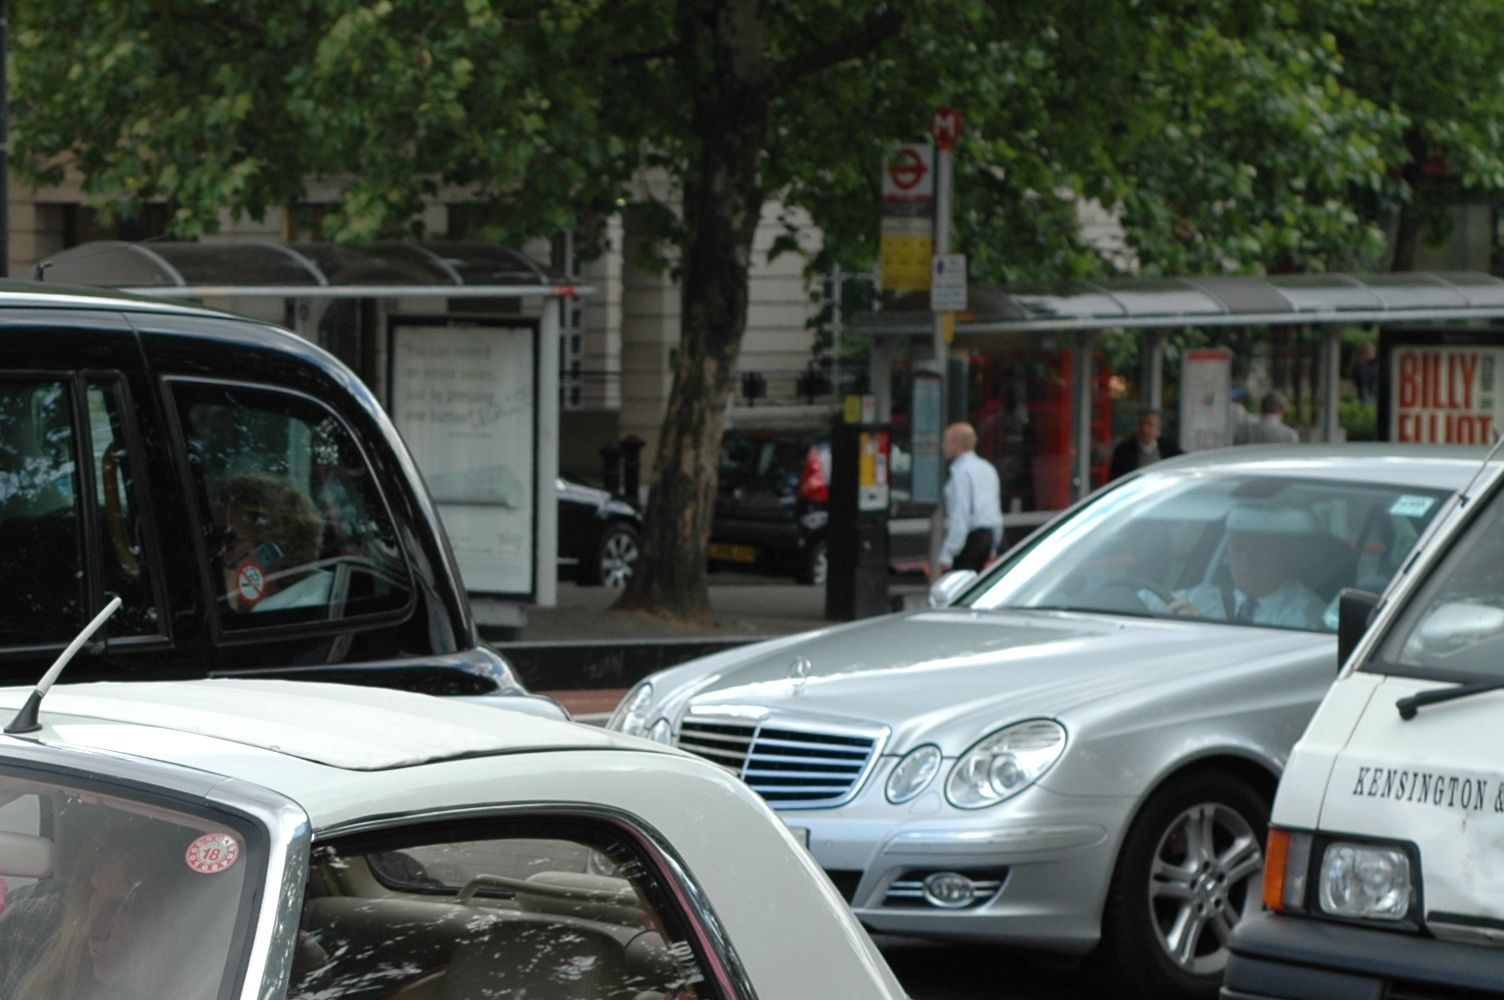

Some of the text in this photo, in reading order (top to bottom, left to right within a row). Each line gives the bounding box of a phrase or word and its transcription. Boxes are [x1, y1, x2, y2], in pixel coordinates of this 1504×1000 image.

[934, 114, 956, 137] M
[1398, 350, 1479, 410] BILLY
[1352, 766, 1488, 813] KENSINGTON
[203, 847, 221, 862] 18
